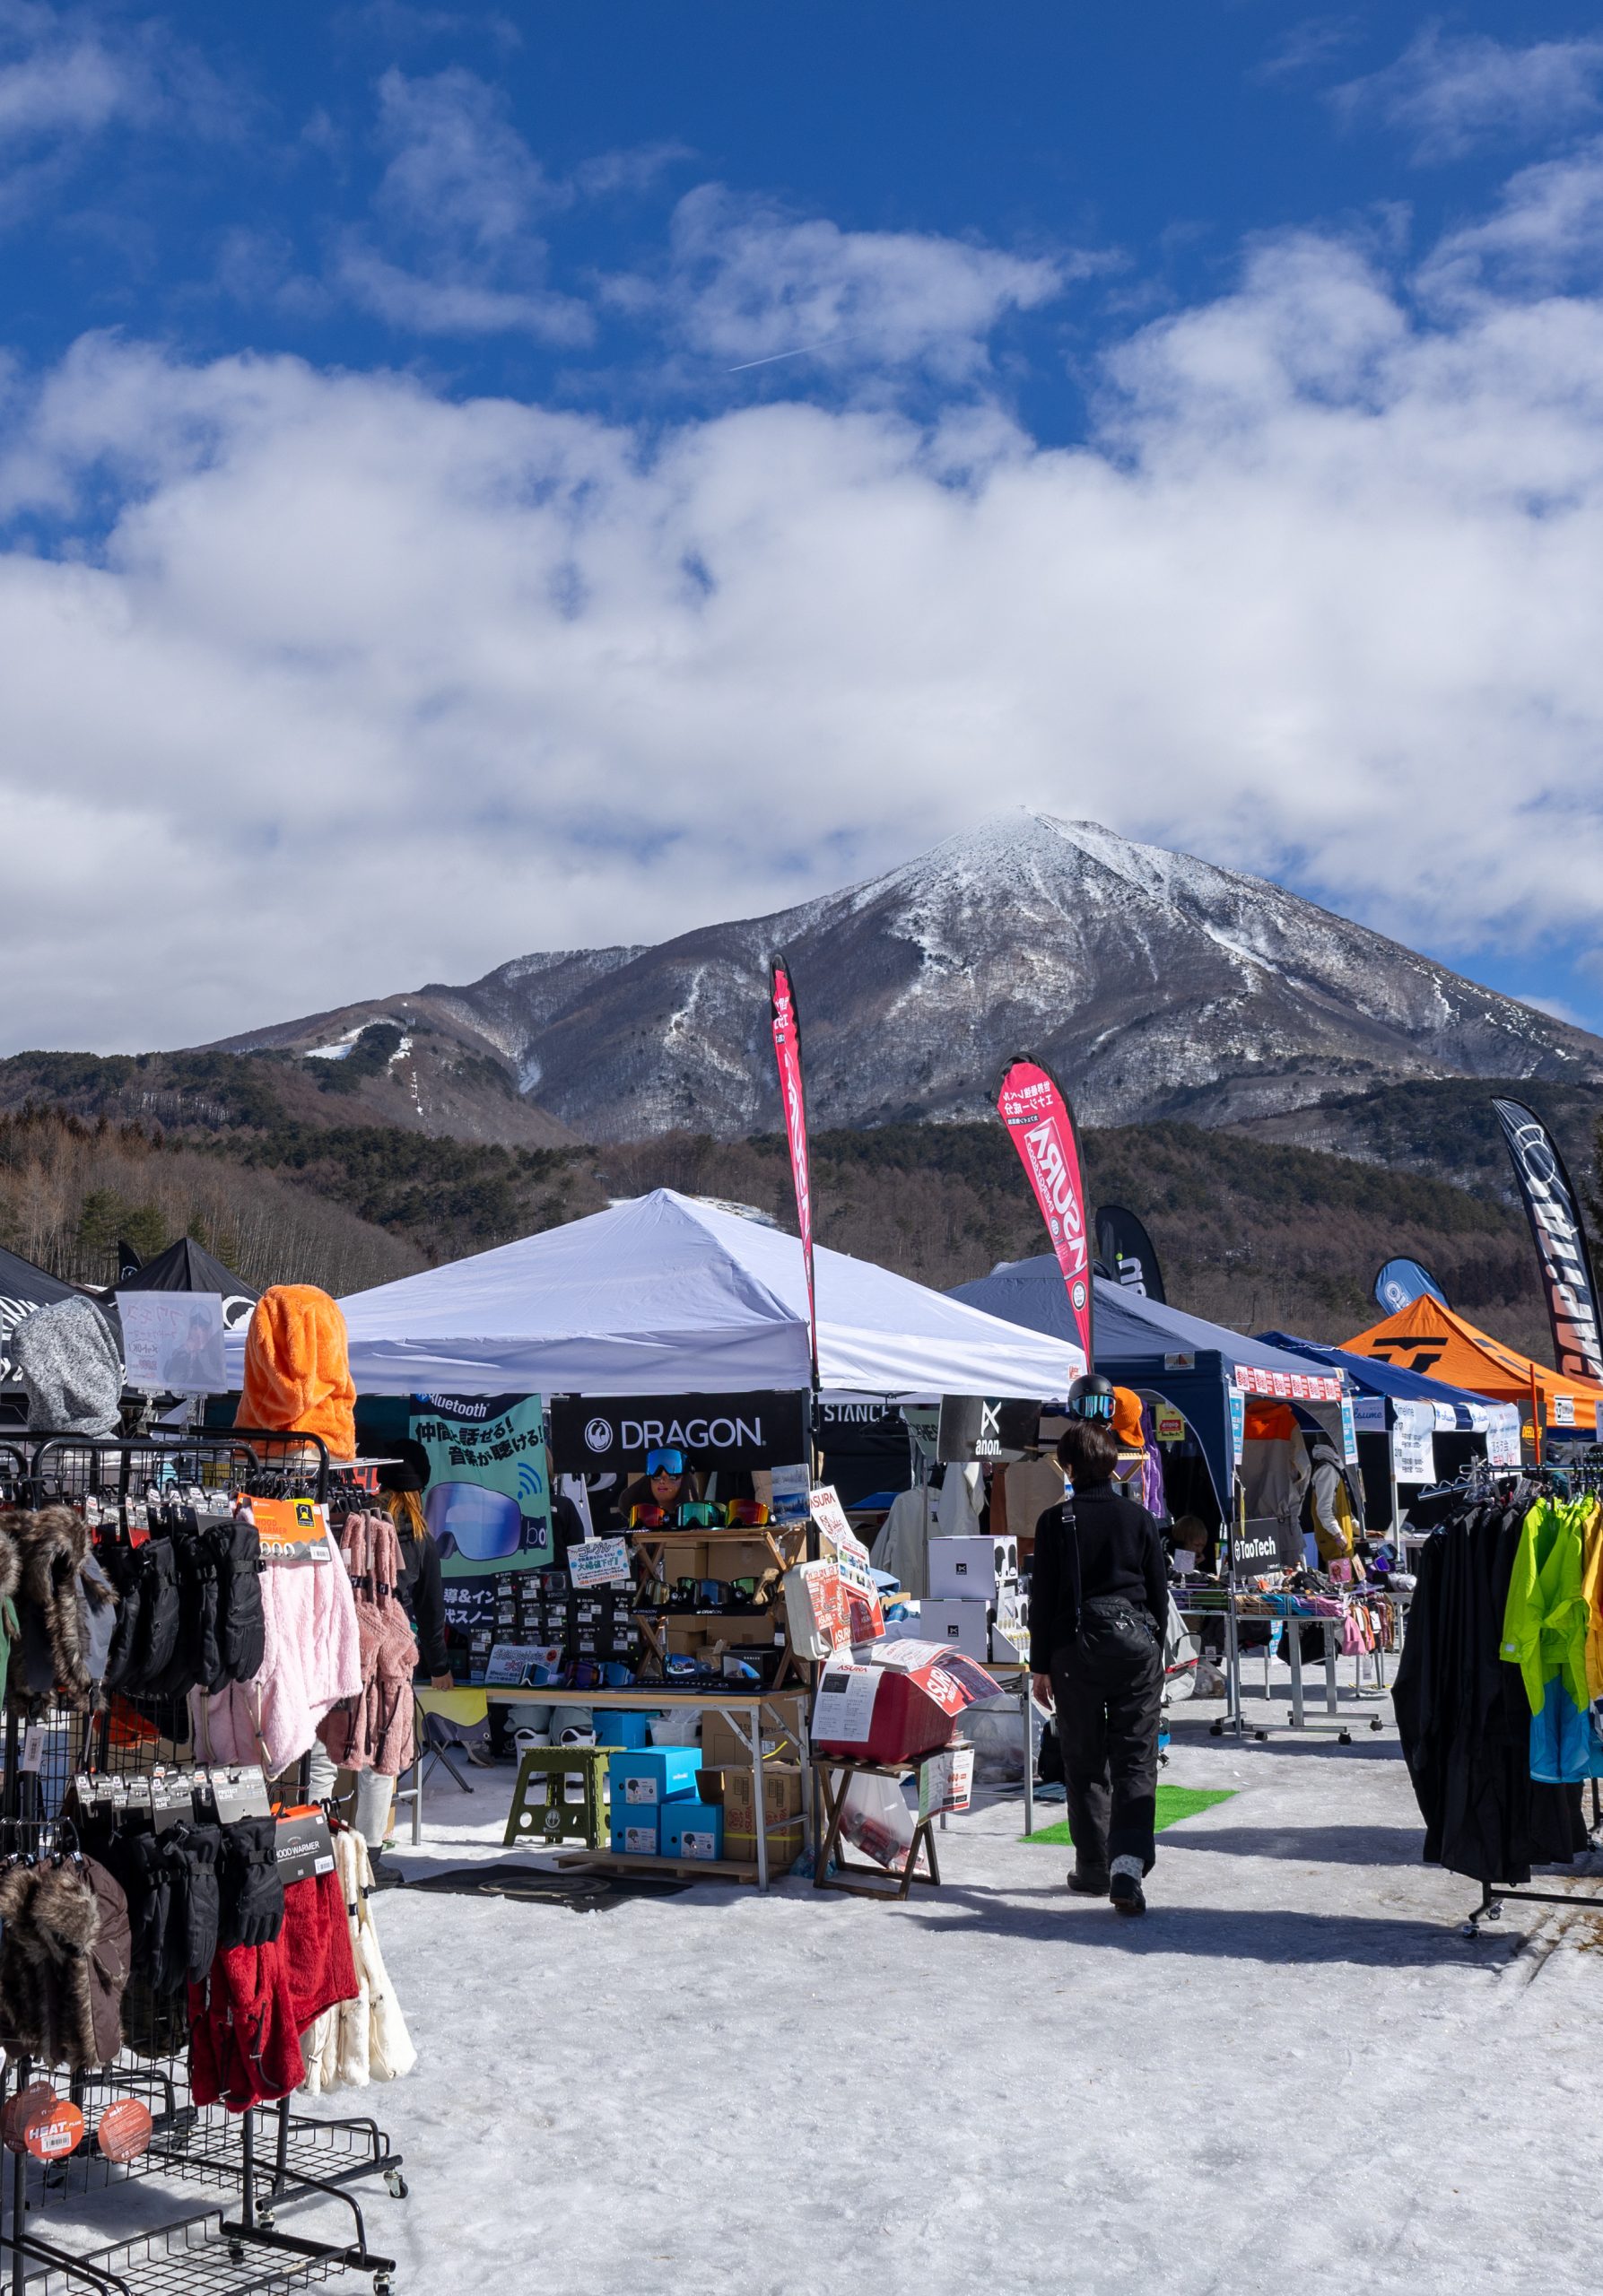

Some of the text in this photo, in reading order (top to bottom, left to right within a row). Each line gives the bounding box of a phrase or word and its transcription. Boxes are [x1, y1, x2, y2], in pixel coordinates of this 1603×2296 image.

[621, 1417, 762, 1449] DRAGON
[449, 1425, 544, 1466] 音楽が聴ける!
[975, 1439, 1002, 1456] anon.
[810, 1492, 836, 1509] ASURA
[1240, 1535, 1276, 1559] TaoTech
[837, 1665, 867, 1673] ASURA
[292, 1840, 320, 1854] WARMER
[29, 2121, 67, 2140] HEAT
